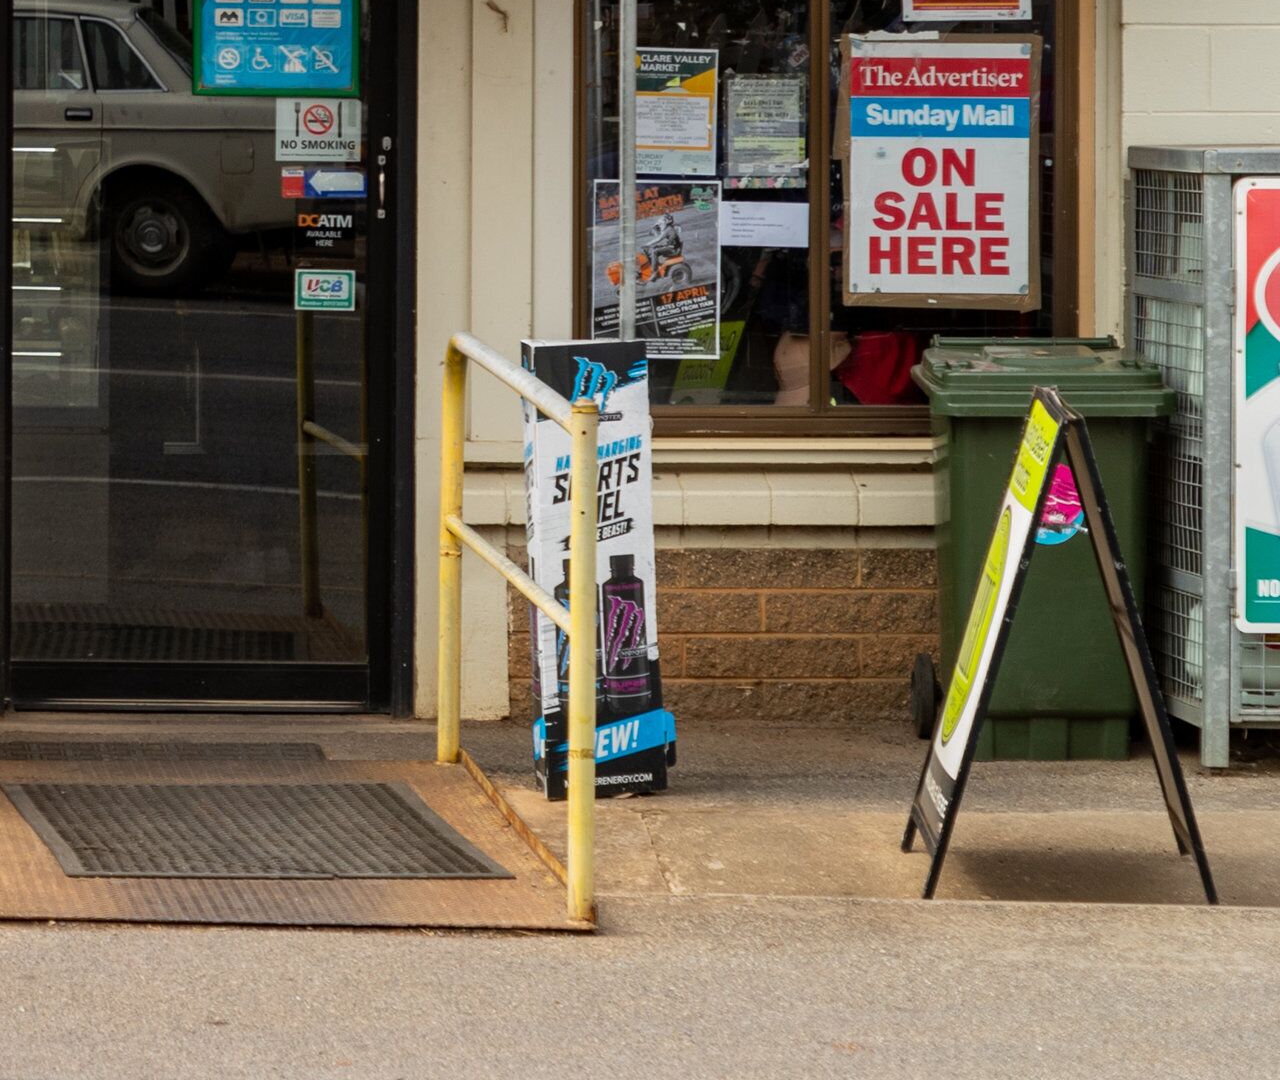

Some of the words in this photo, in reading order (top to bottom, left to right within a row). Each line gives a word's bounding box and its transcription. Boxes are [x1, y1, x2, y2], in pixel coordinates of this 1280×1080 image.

[640, 54, 673, 63] CLARE
[674, 55, 712, 64] VALLEY
[640, 63, 681, 73] MARKET
[859, 65, 903, 87] The
[907, 66, 1024, 88] Advertiser
[866, 103, 961, 132] Sunday
[962, 104, 1015, 126] Mail
[280, 139, 298, 150] NO
[301, 139, 356, 151] SMOKING
[901, 147, 977, 188] ON
[872, 191, 1005, 232] SALE
[306, 229, 342, 239] AVAILABLE
[315, 239, 334, 247] HERE
[868, 236, 1010, 276] HERE
[676, 286, 709, 299] APRIL
[656, 303, 676, 312] GATES
[676, 299, 693, 308] OPEN
[657, 308, 680, 317] RACING
[681, 304, 699, 313] FROM
[596, 434, 642, 460] HARGING
[552, 452, 641, 505] SRTS
[602, 521, 628, 537] BEAST!
[595, 720, 640, 759] EW!
